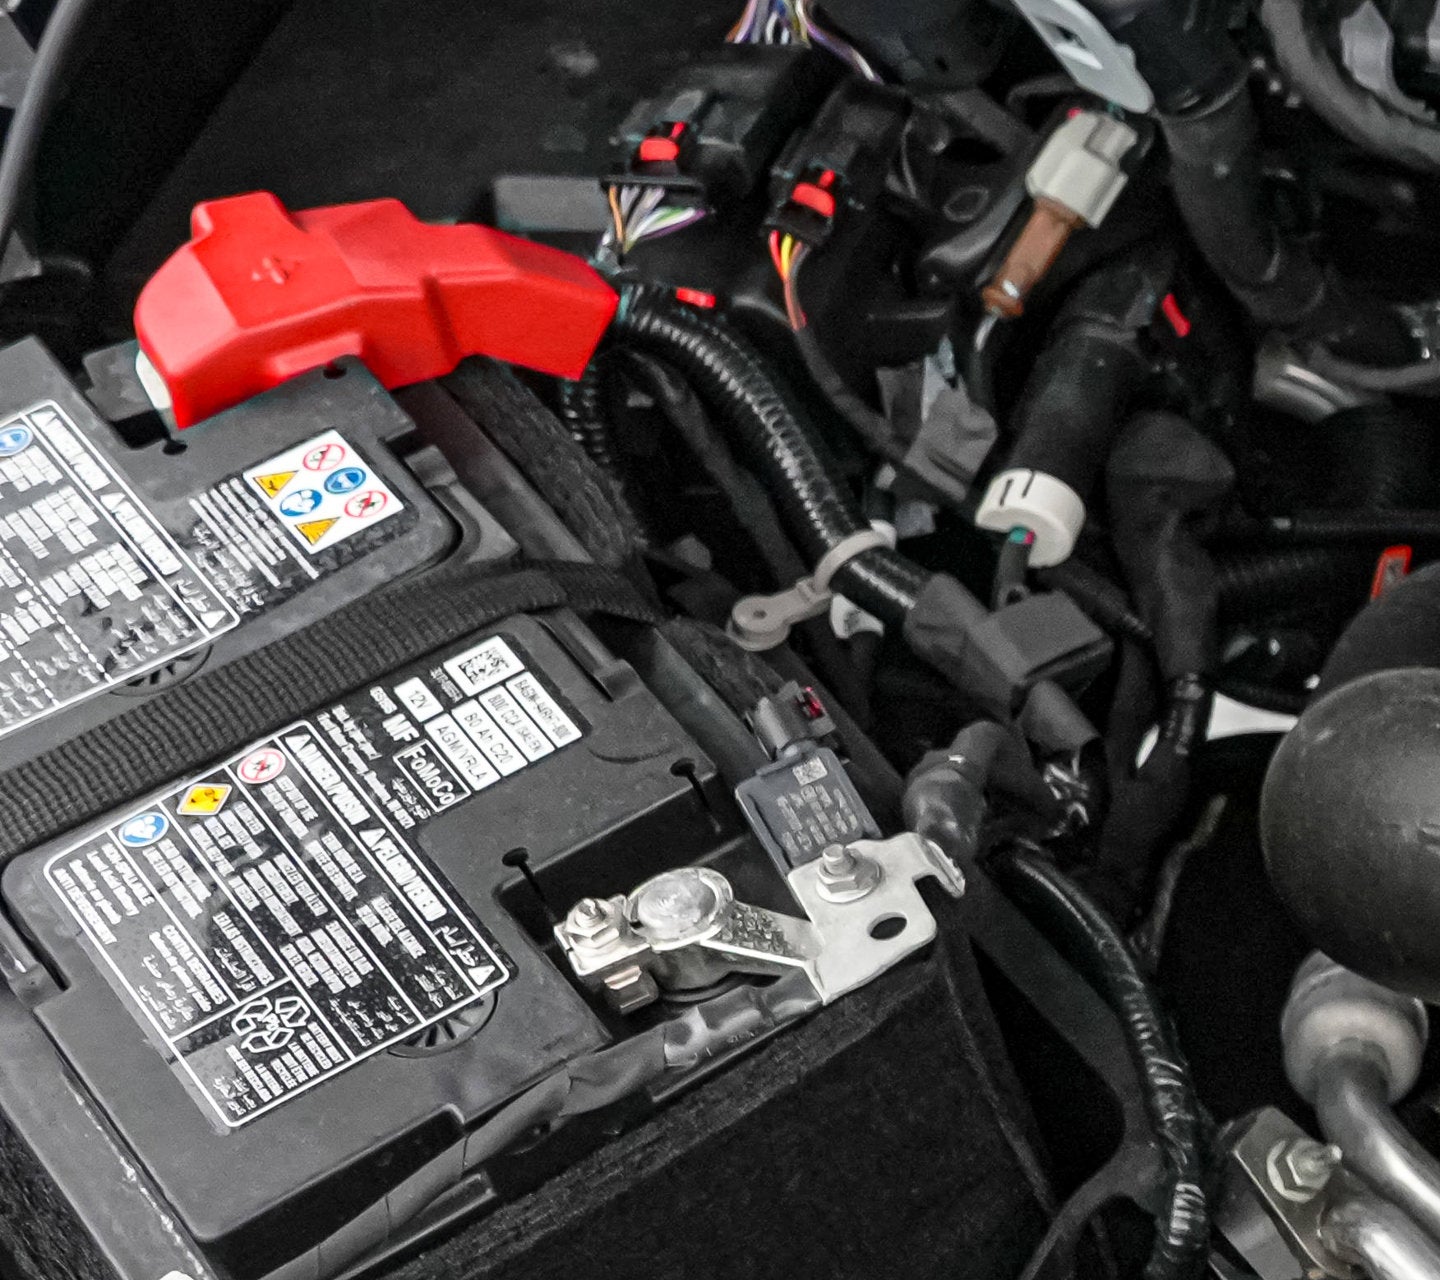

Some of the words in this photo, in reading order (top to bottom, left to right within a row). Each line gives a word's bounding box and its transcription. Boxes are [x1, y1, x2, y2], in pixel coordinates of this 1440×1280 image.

[405, 689, 431, 711] 12V
[379, 712, 420, 745] MF
[401, 746, 462, 807] FoMoCo
